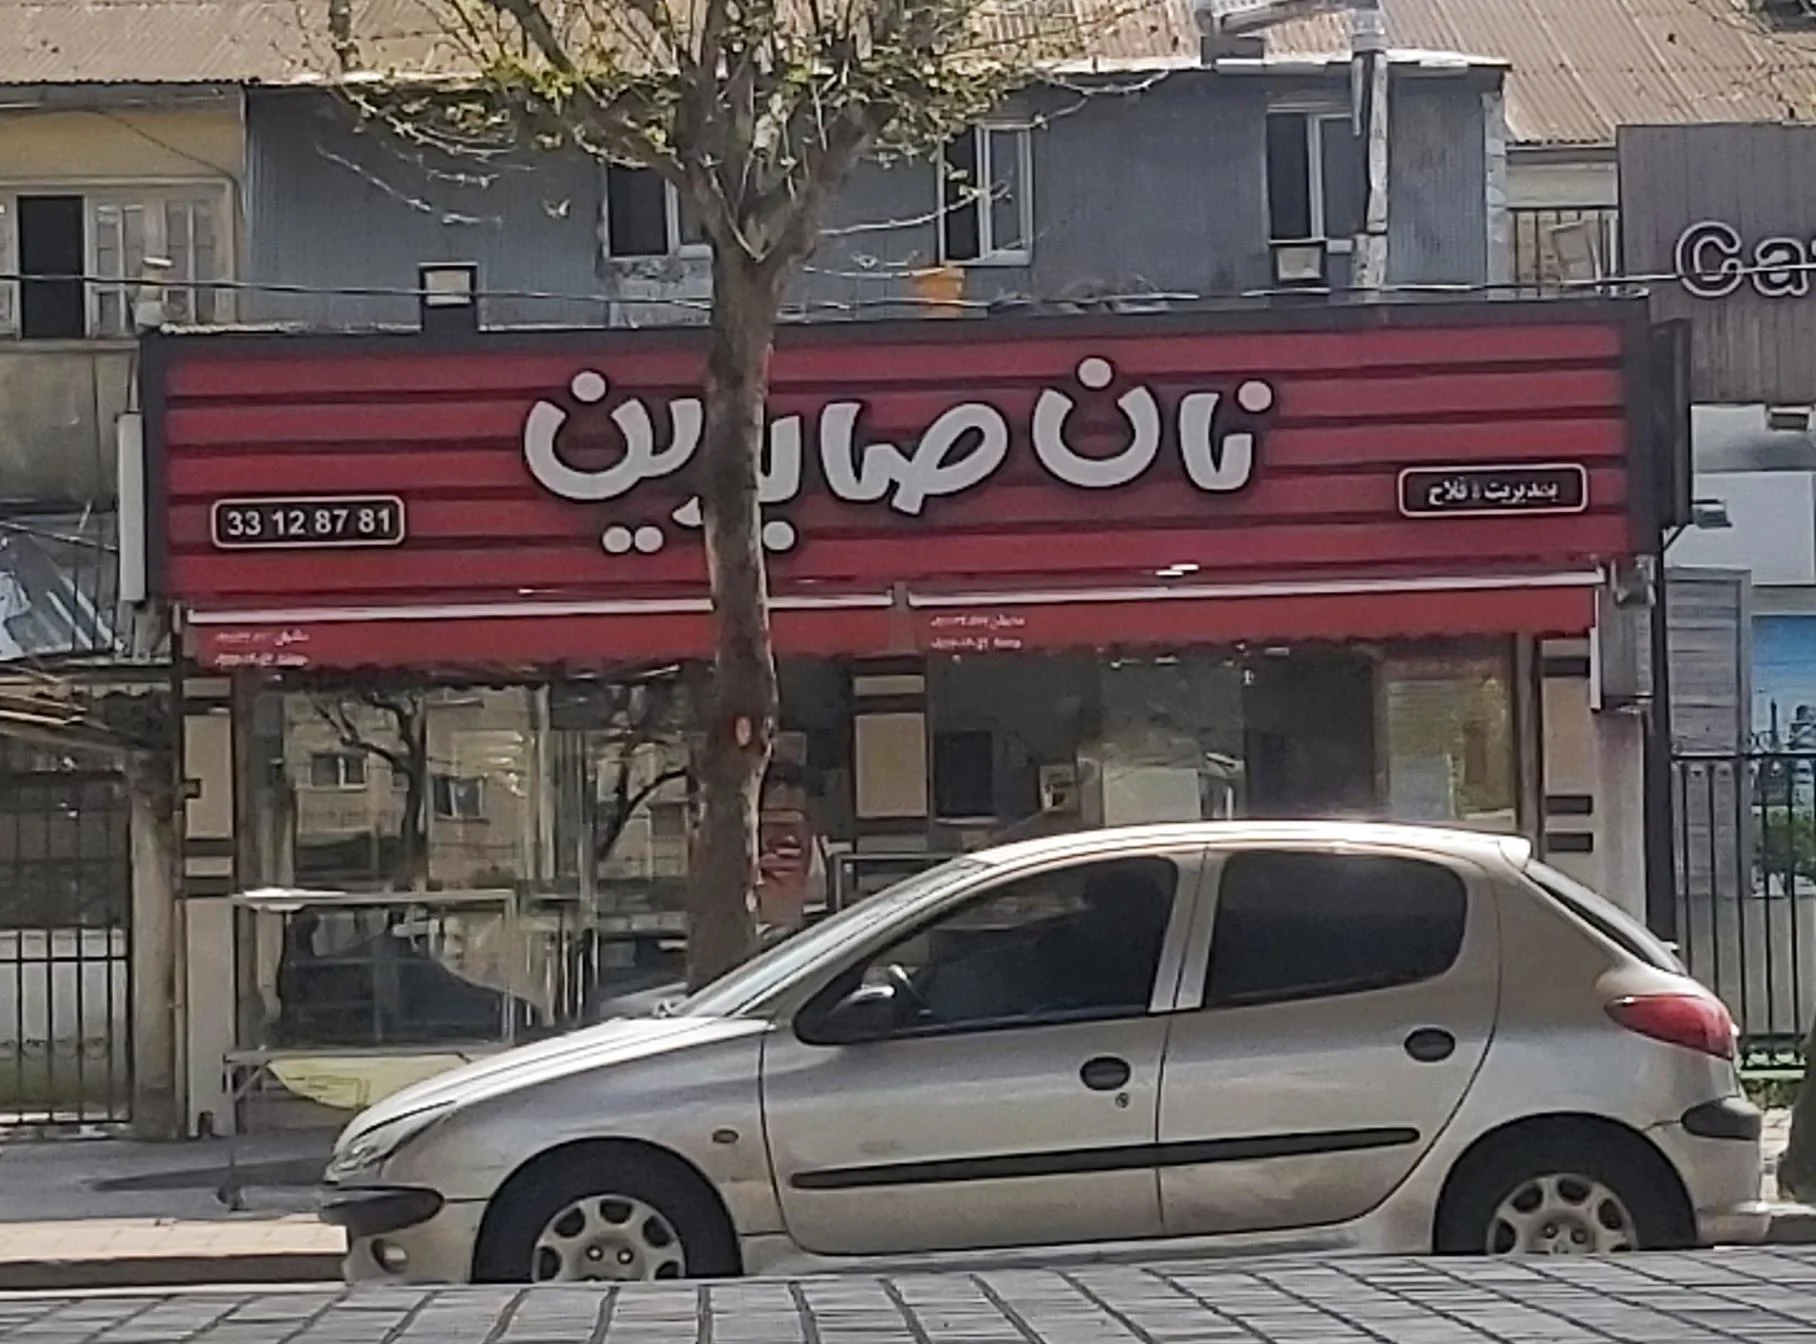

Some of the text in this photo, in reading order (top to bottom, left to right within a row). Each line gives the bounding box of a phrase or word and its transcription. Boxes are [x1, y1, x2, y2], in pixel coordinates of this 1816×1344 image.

[1675, 220, 1816, 296] Ca
[1032, 356, 1273, 491] نان
[1428, 476, 1467, 505] فلاح
[227, 508, 390, 536] 33 12 87 81
